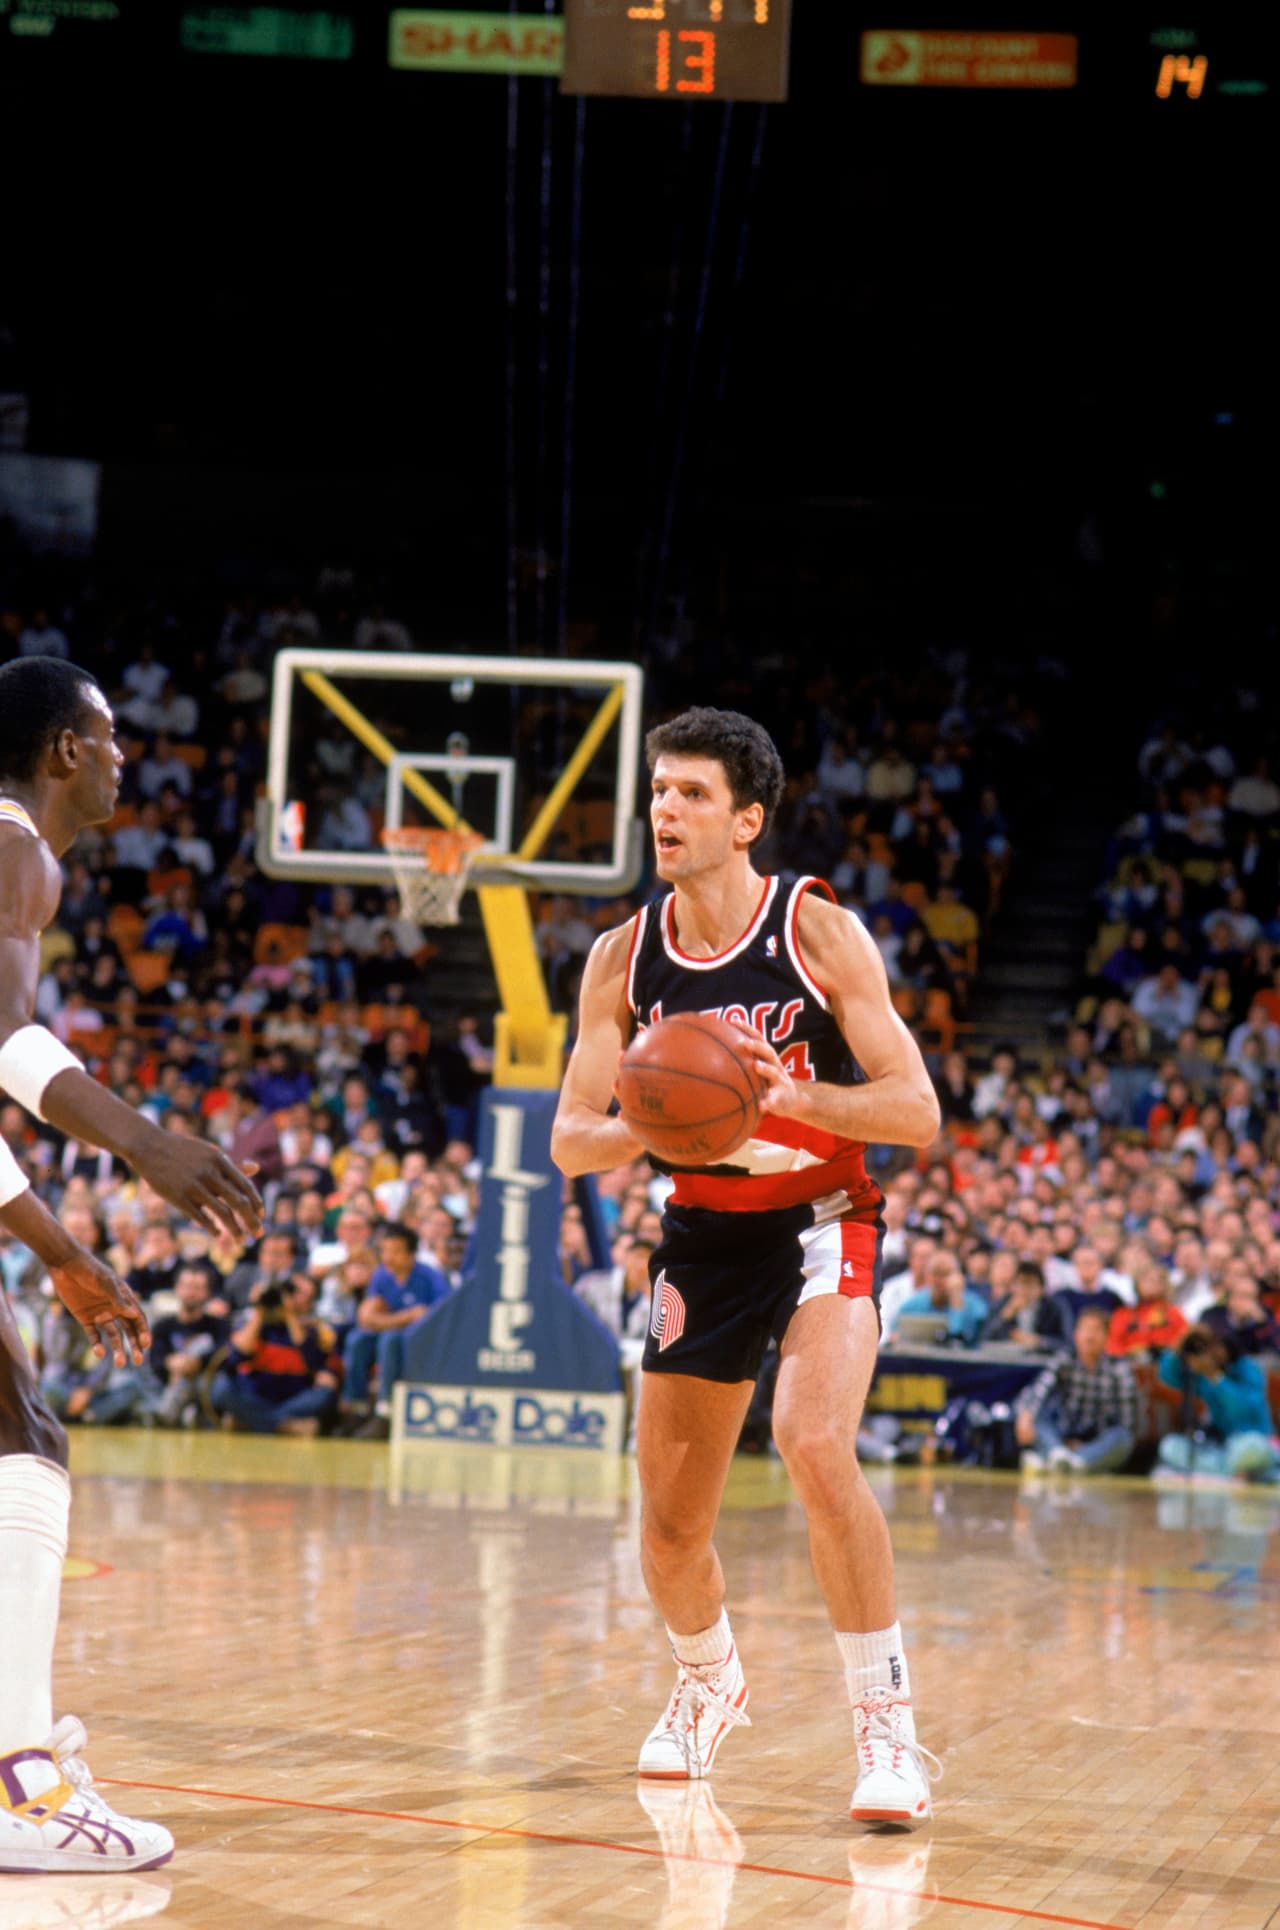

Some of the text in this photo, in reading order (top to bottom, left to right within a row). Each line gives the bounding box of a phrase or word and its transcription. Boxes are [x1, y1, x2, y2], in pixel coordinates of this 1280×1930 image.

[656, 30, 716, 92] 13
[1156, 54, 1208, 98] 14
[404, 1390, 607, 1446] Dole Dole
